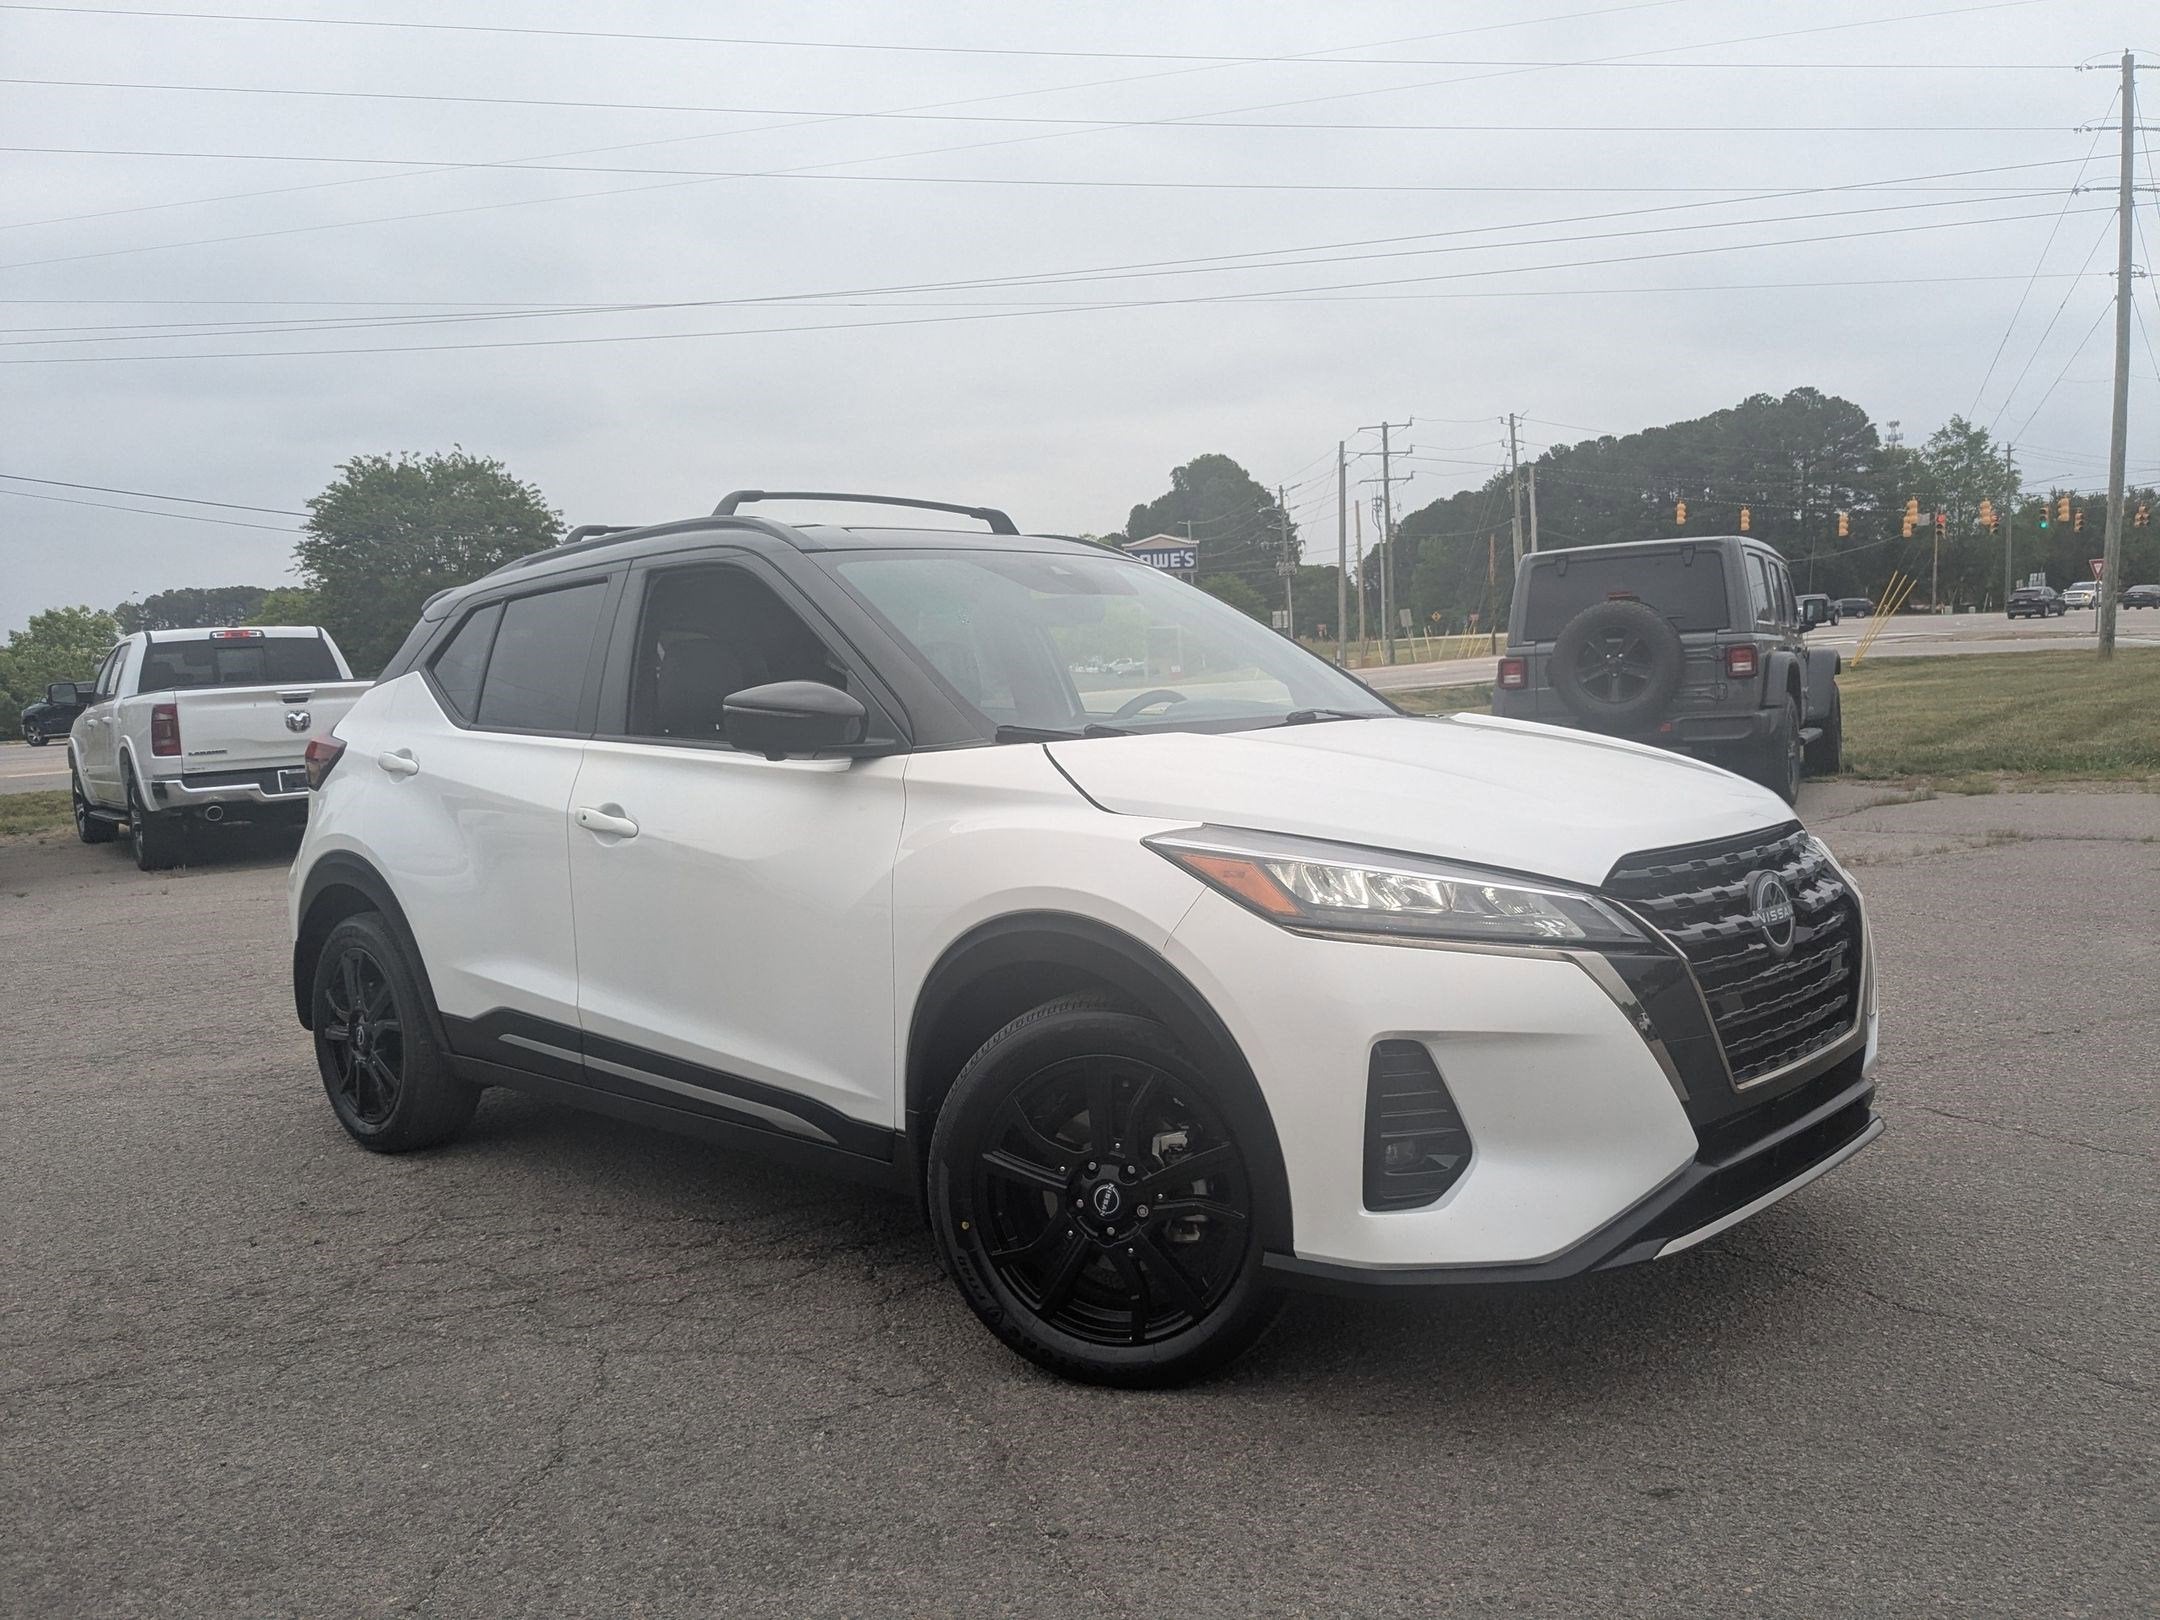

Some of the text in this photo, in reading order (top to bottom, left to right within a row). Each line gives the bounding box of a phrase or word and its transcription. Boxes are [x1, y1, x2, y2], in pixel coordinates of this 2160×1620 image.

[1130, 550, 1195, 568] OWE'S
[1752, 903, 1794, 923] NISSAN
[1099, 1182, 1115, 1217] NISSAN
